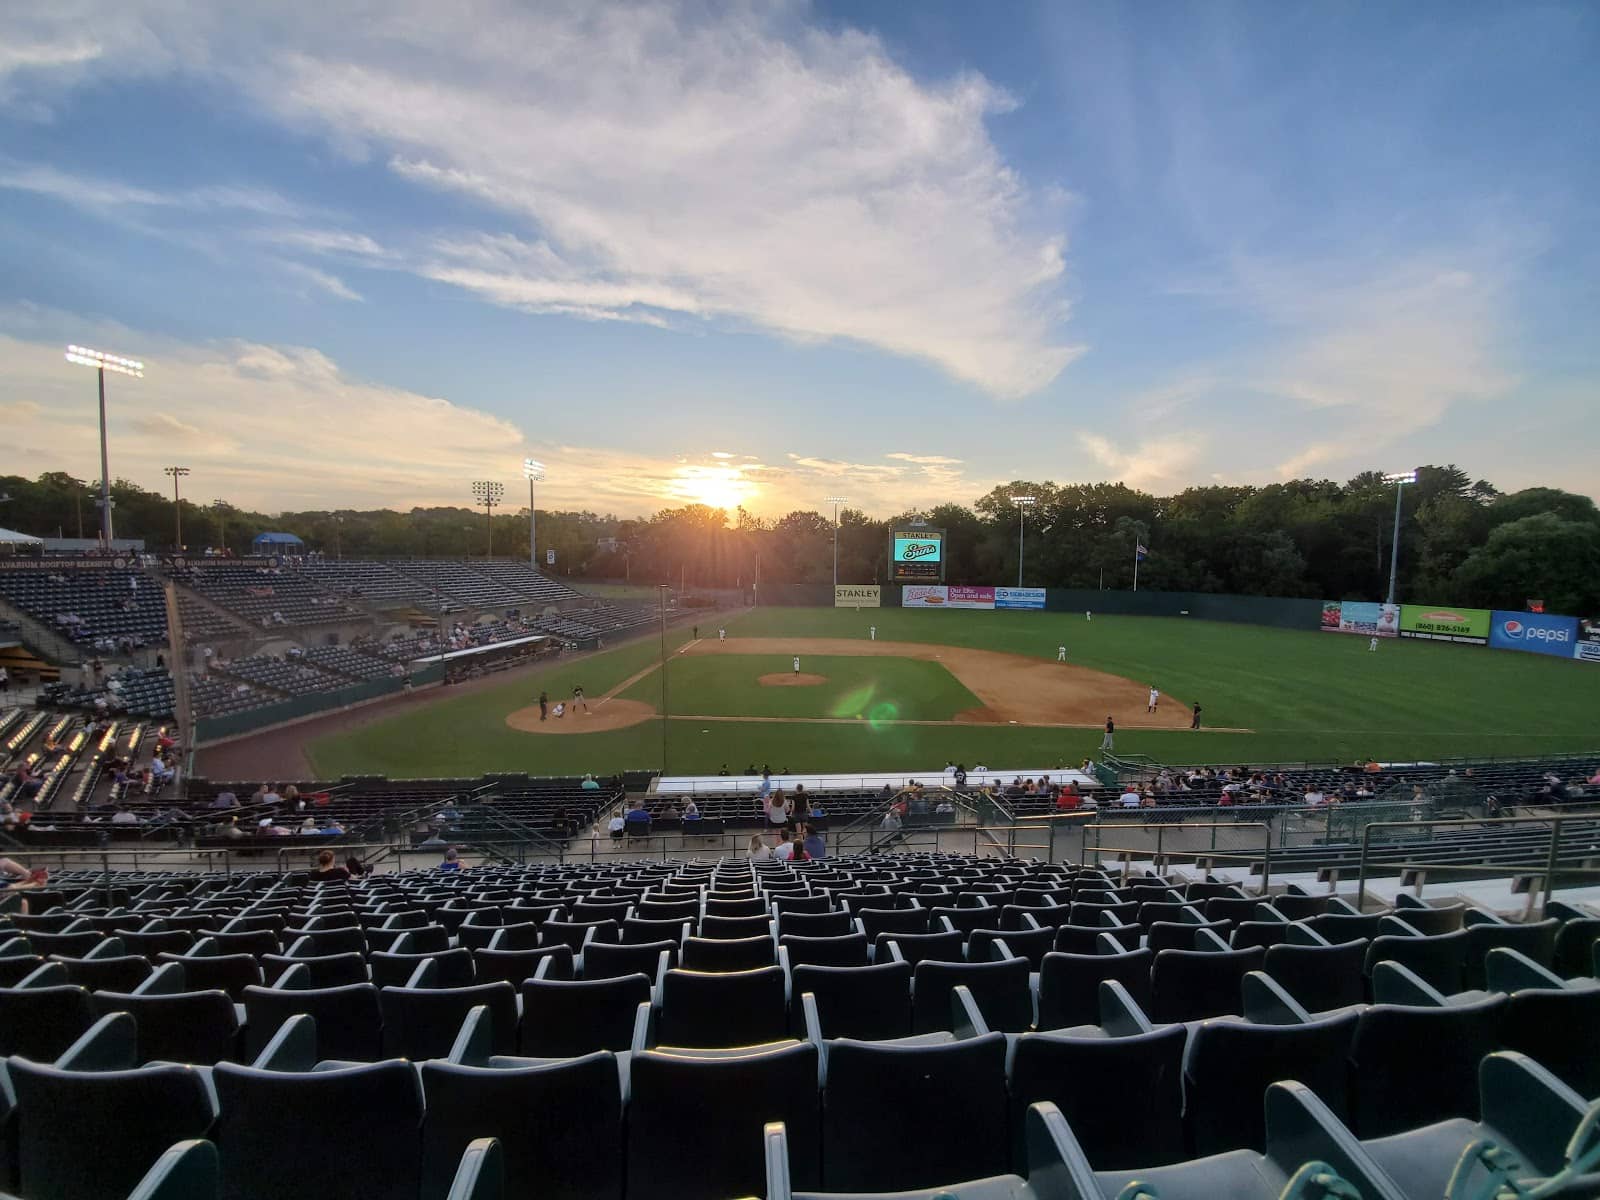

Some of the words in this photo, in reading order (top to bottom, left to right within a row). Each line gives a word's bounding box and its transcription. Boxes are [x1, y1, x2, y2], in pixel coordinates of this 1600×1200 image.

[903, 543, 937, 560] Suns
[836, 589, 879, 598] STANLEY
[1526, 627, 1569, 643] pepsi
